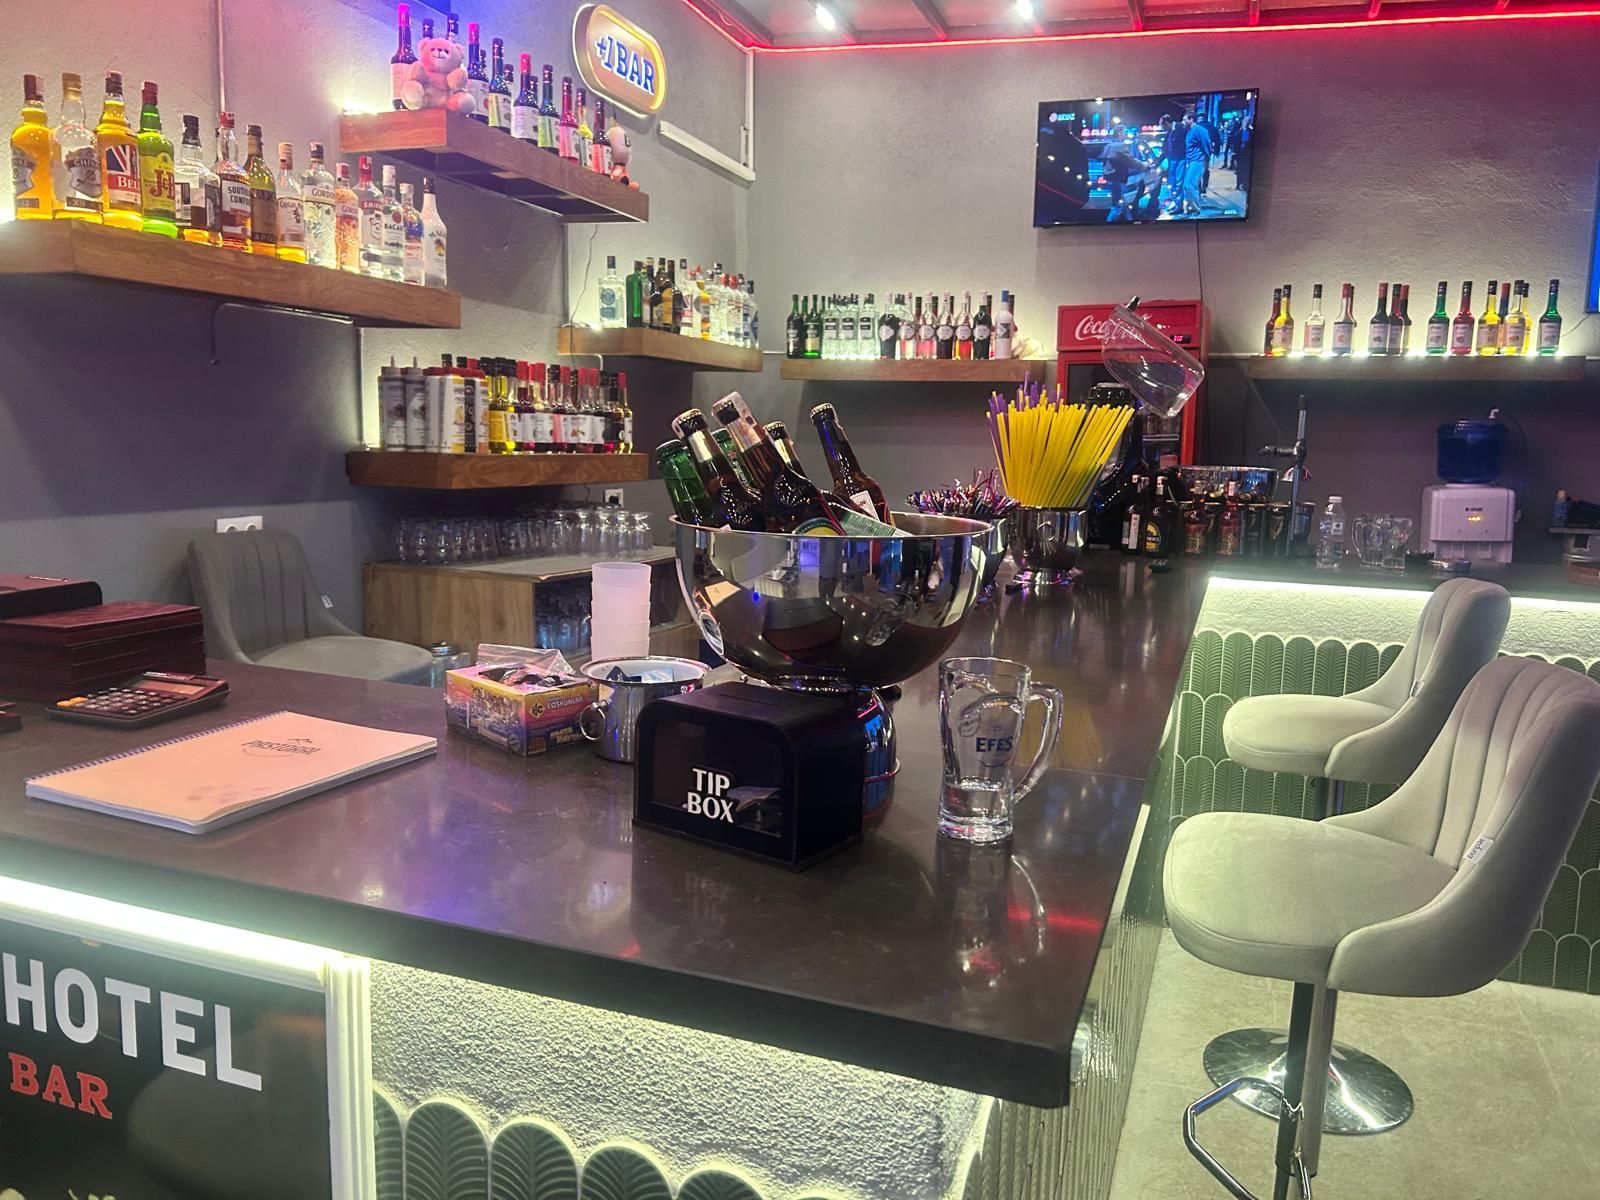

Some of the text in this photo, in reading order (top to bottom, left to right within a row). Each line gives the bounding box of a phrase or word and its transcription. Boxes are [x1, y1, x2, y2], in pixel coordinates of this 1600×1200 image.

[975, 736, 1014, 752] EFES
[692, 767, 730, 797] TIP
[687, 791, 734, 823] BOX
[2, 953, 262, 1091] HOTEL
[8, 1051, 113, 1120] BAR
